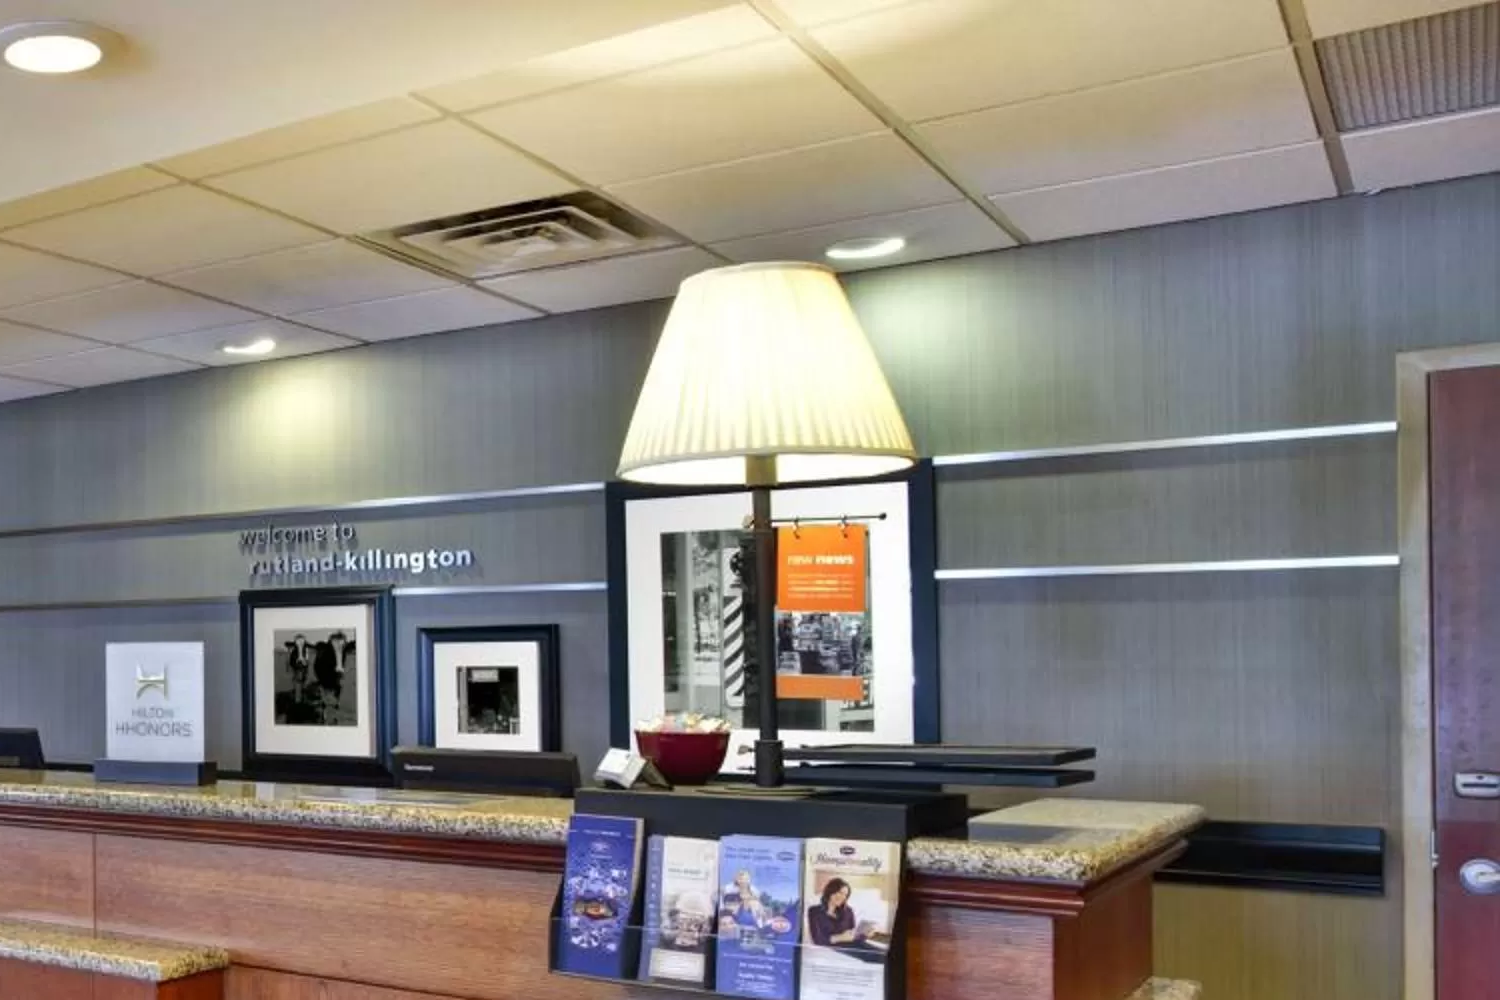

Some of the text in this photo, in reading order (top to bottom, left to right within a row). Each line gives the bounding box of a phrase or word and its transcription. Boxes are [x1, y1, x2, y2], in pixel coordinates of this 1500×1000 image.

[240, 521, 356, 545] welcome to
[251, 548, 472, 576] rutland-killington
[815, 555, 853, 565] news
[116, 721, 193, 737] HHONORS
